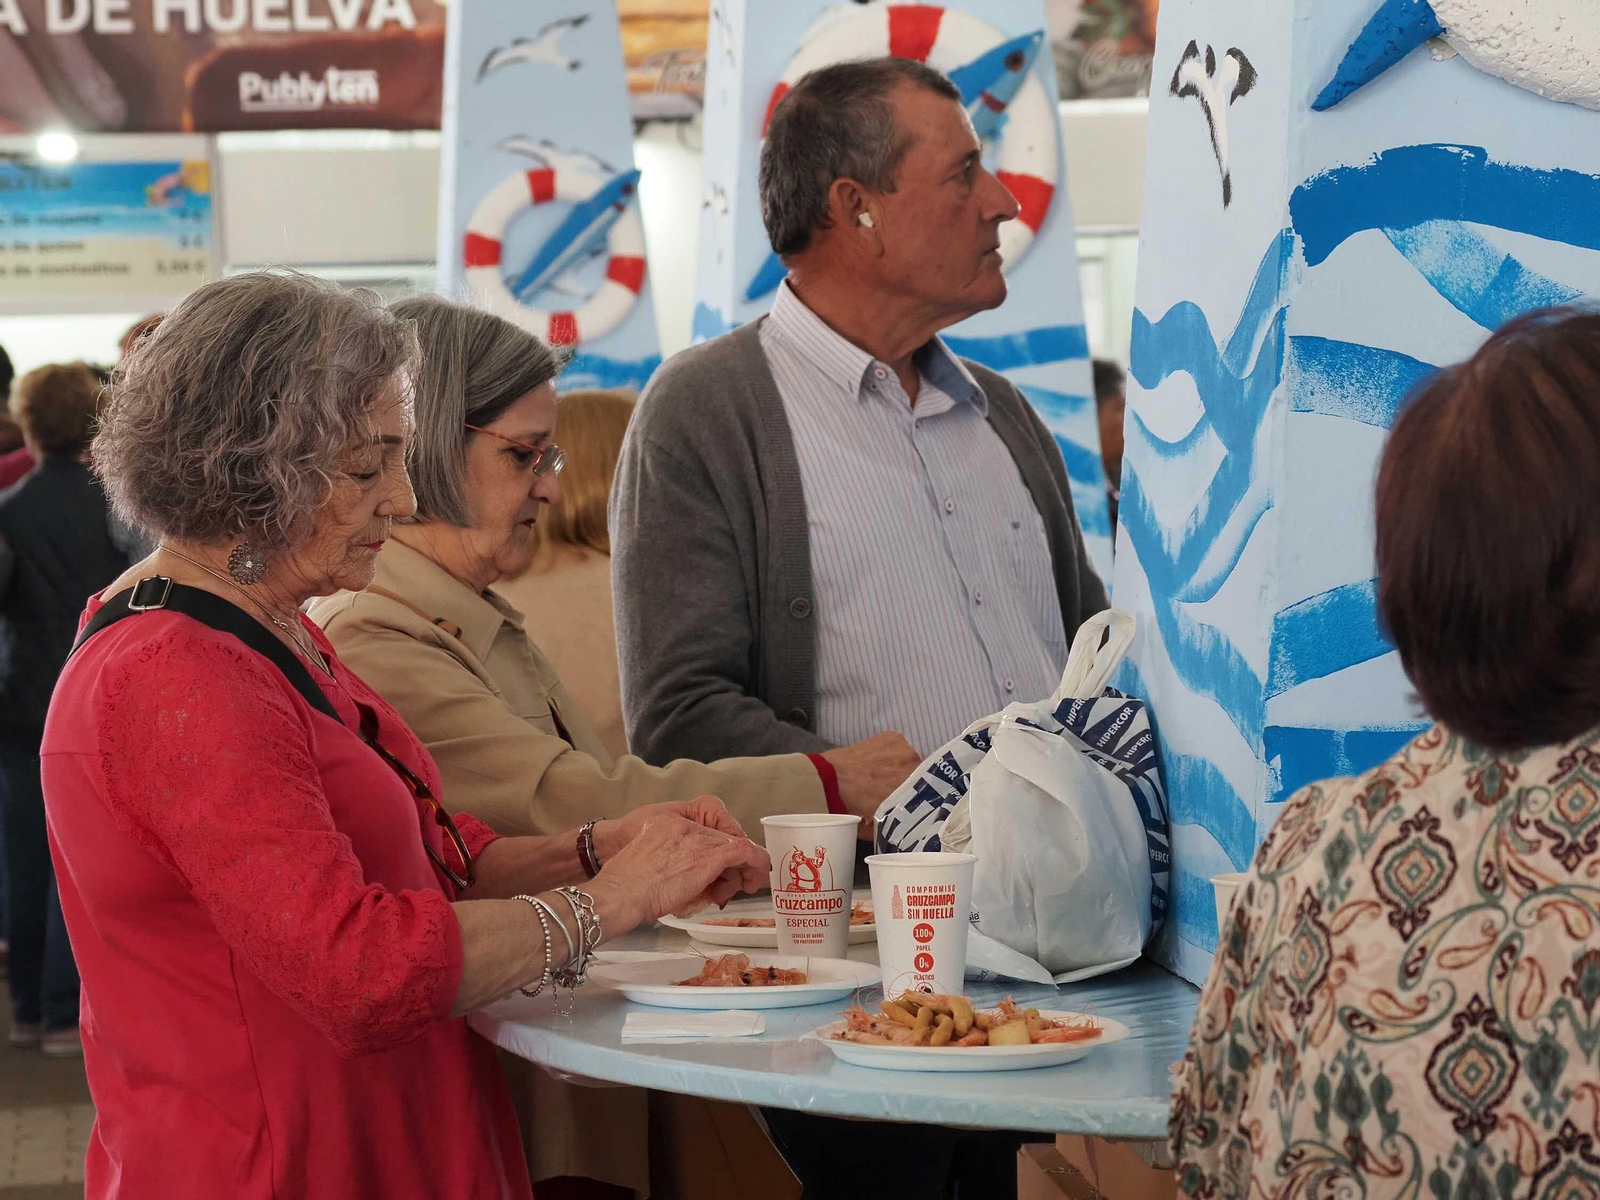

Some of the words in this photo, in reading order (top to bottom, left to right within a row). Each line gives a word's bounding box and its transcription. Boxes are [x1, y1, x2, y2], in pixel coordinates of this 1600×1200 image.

[46, 0, 135, 34] DE
[152, 0, 417, 34] HUELVA
[1096, 706, 1134, 748] HIPERCOR
[906, 884, 956, 894] COMPROMISO
[775, 894, 843, 911] Cruzcampo
[906, 893, 956, 907] CRUZCAMPO
[907, 908, 920, 920] SIN
[922, 907, 954, 920] HUELLA
[786, 918, 830, 928] ESPECIAL
[914, 928, 934, 938] 100%
[915, 944, 932, 952] PAPEL
[918, 956, 930, 969] 0%
